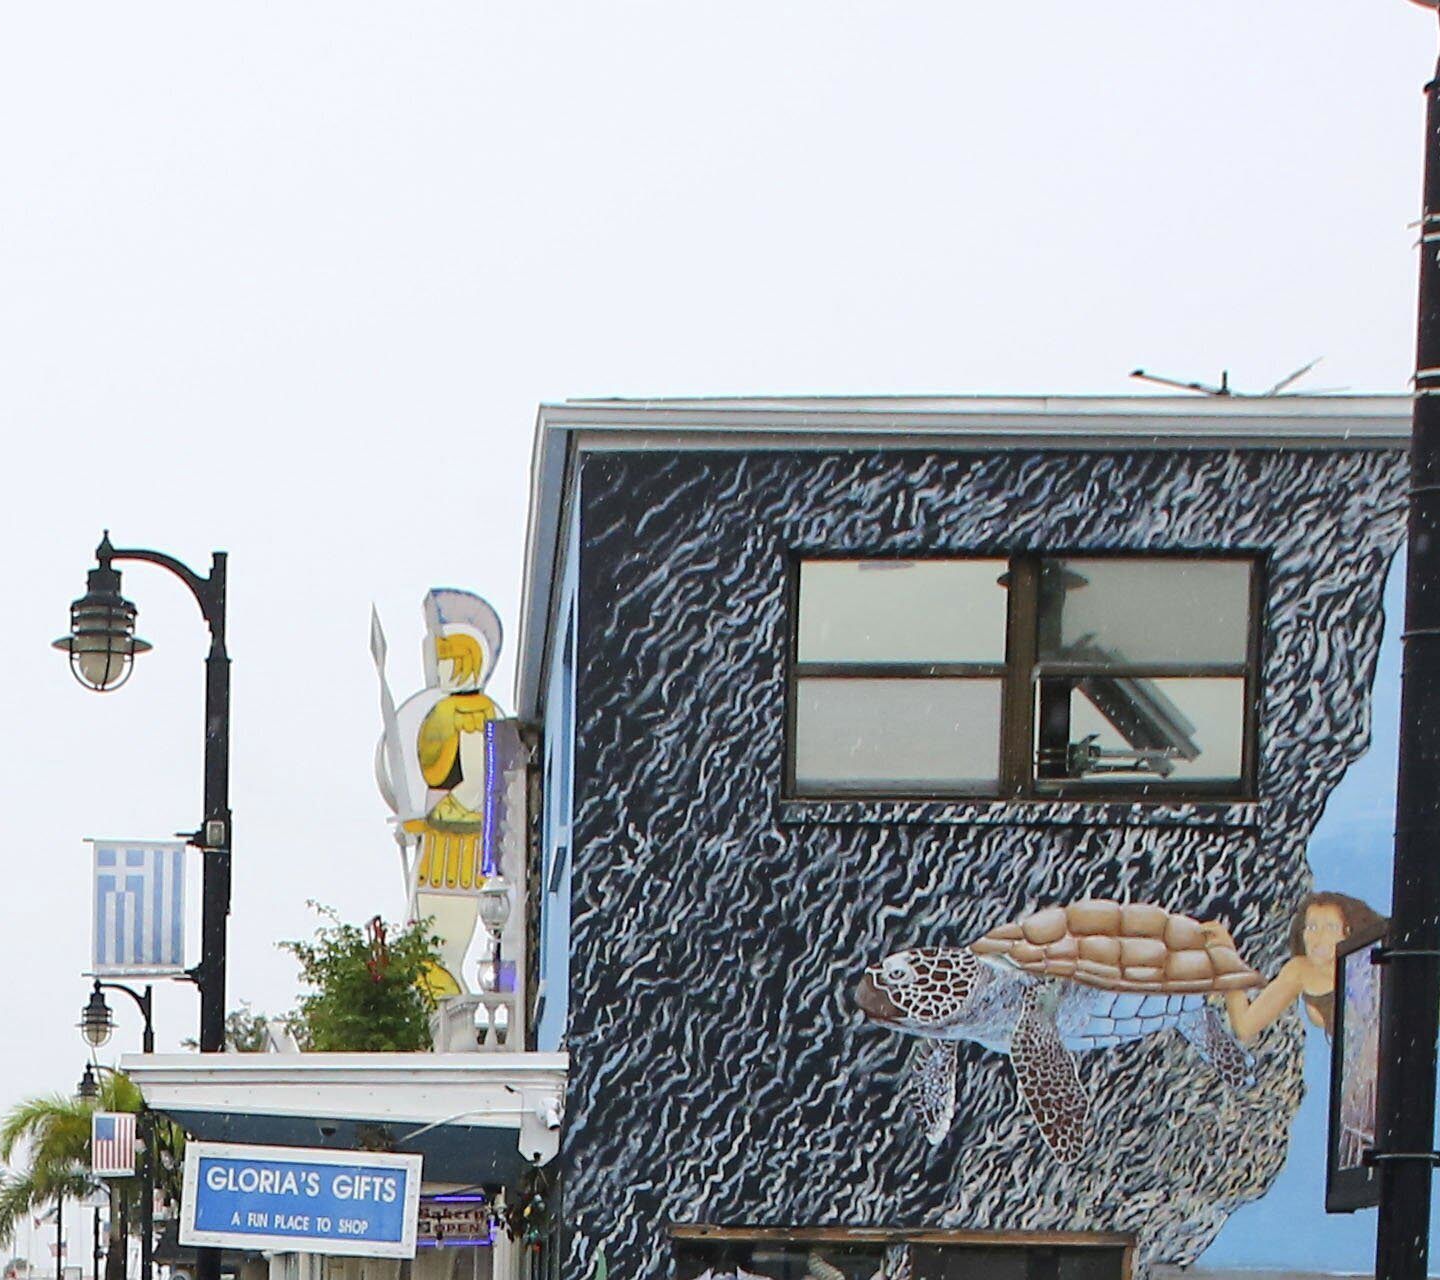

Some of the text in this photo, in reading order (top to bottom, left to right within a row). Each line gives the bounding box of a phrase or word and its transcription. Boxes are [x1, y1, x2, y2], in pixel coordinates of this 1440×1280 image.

[206, 1166, 397, 1203] GLORIA'S GIFTS
[231, 1211, 369, 1234] A FUN PLACE TO SHOP
